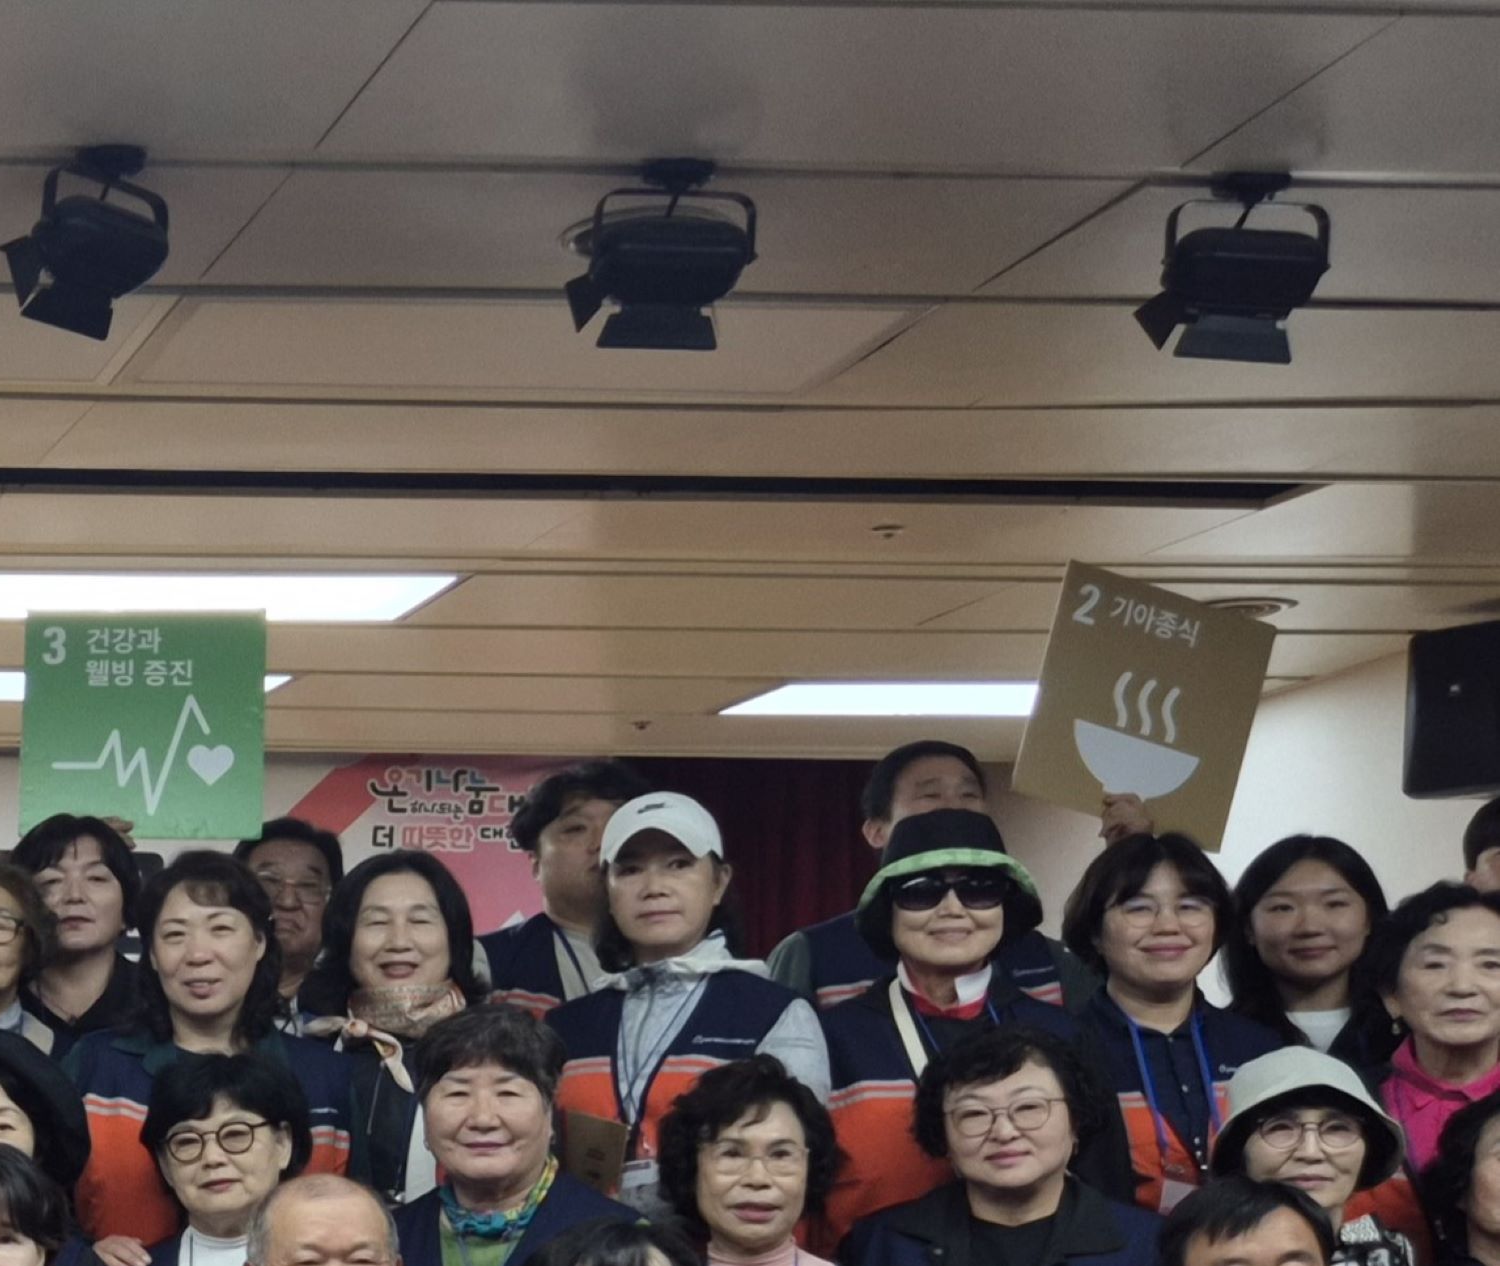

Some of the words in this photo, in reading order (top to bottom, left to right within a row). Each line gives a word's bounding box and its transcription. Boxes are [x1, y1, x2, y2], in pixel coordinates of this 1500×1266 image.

[1072, 584, 1100, 625] 2
[1110, 596, 1200, 648] 기아종식
[42, 626, 66, 665] 3
[87, 627, 162, 654] 건강과
[85, 659, 134, 687] 웰빙
[143, 659, 193, 686] 증진
[372, 825, 394, 847] 더
[402, 826, 473, 849] 따뜻한
